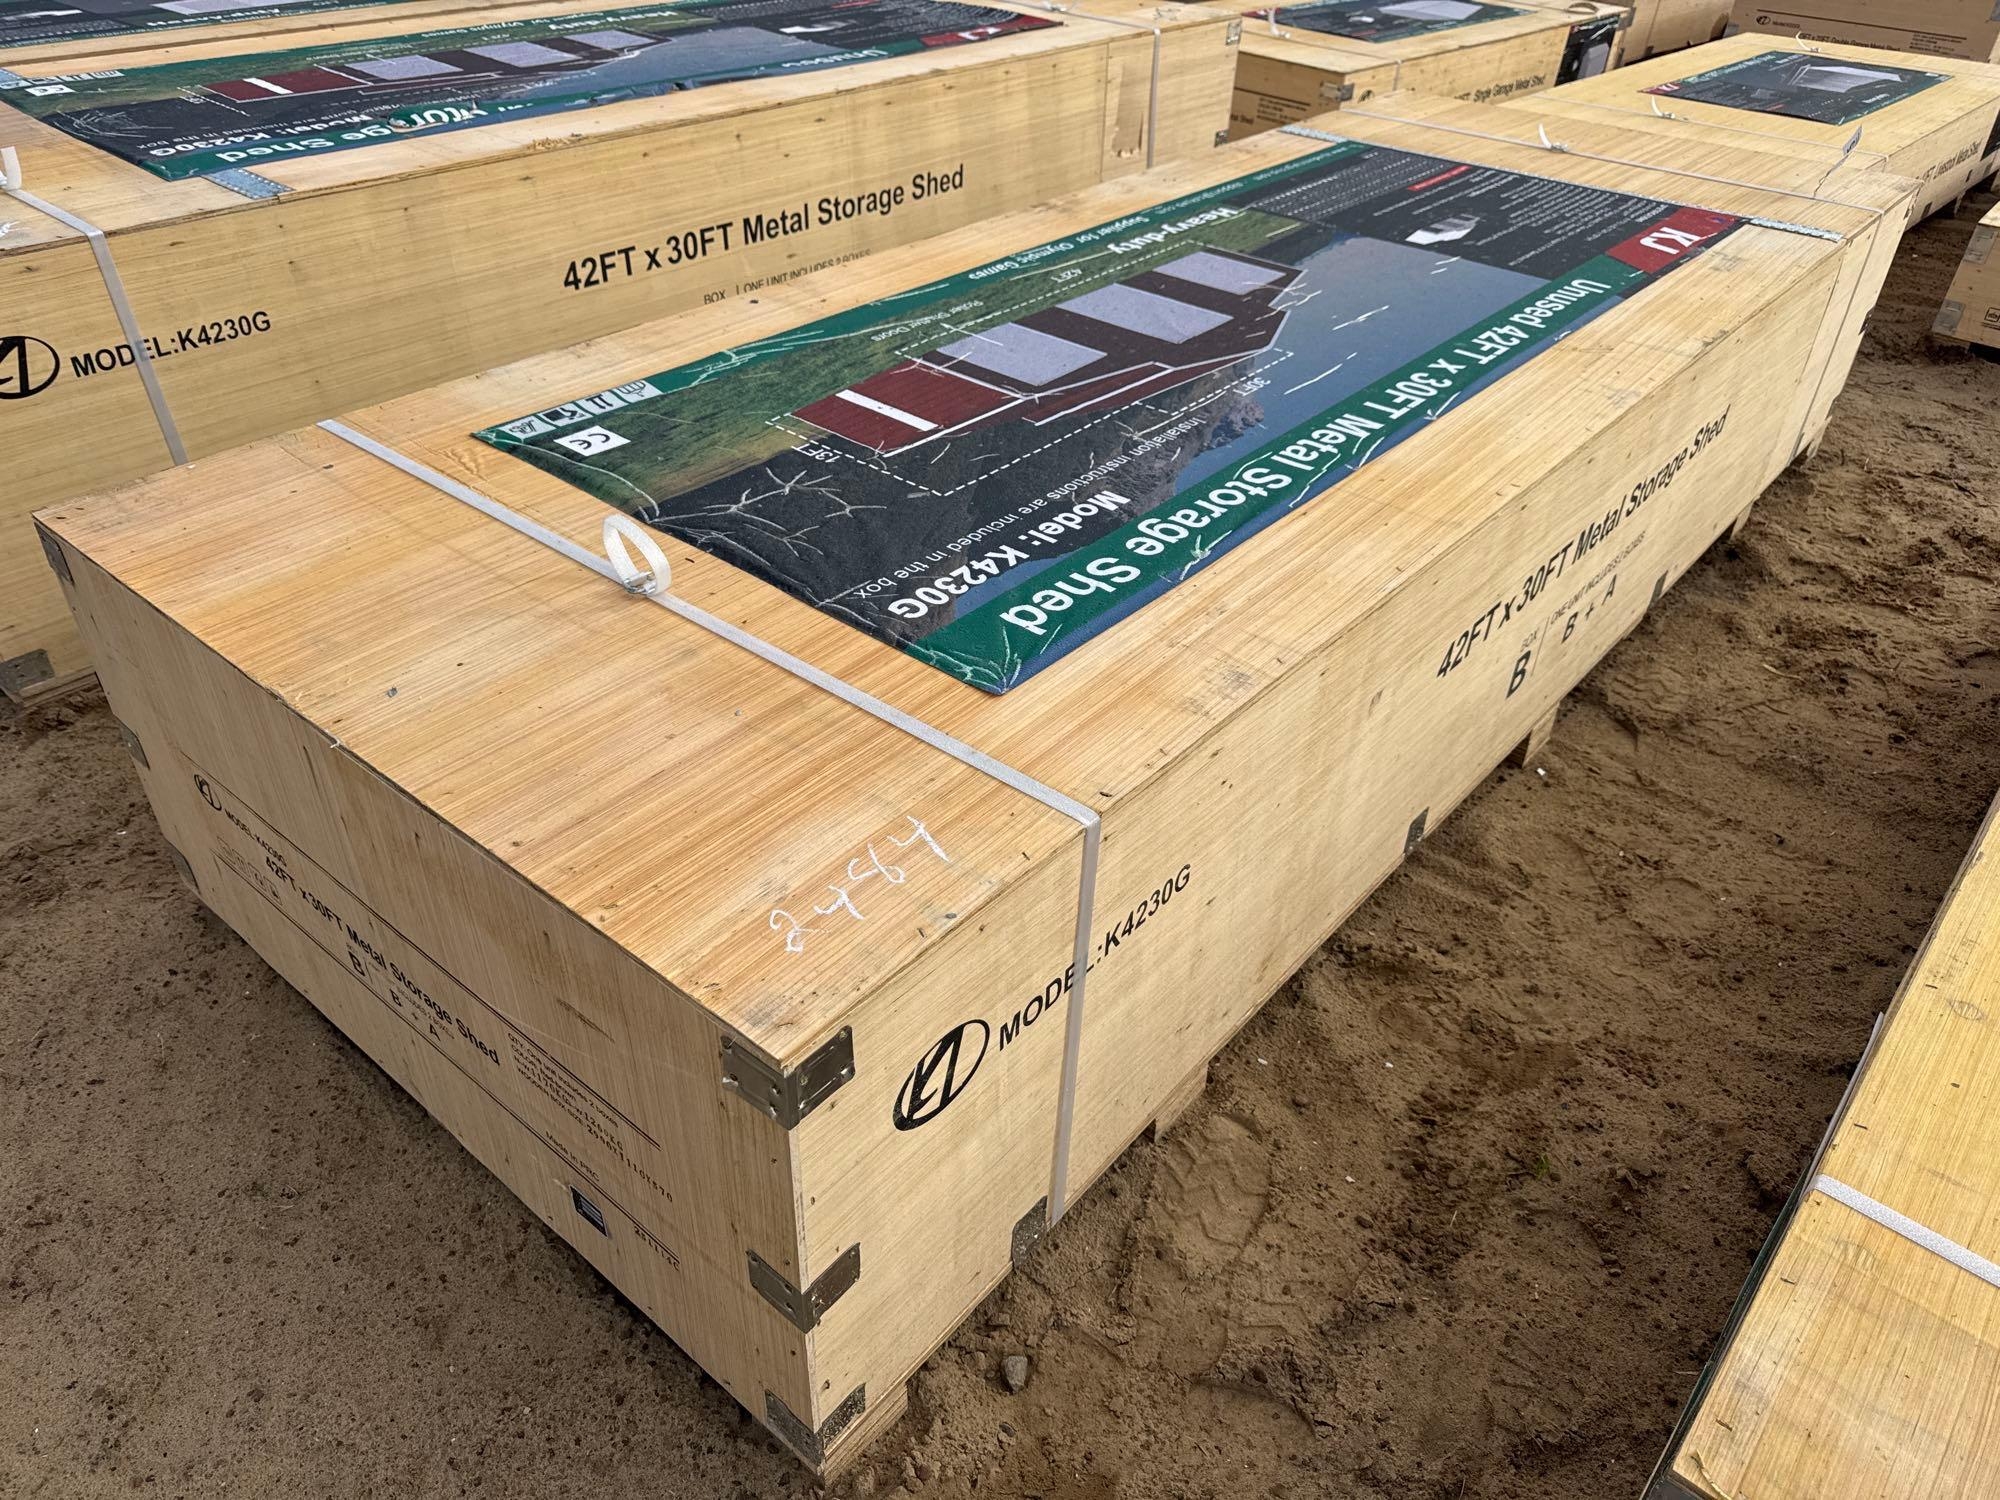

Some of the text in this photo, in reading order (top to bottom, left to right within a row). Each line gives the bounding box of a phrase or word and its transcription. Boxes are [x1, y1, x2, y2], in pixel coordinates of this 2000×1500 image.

[215, 137, 335, 163] Shed
[564, 164, 964, 291] 42FT x 30FT Metal Storage Shed
[1108, 207, 1237, 253] Heavy-duty
[1640, 227, 1702, 254] KJ
[704, 289, 726, 305] BOX
[1001, 279, 1610, 633] Unused 42FT x 30FT Metal Storage Shed
[853, 417, 1205, 598] Installation instructions are included in the box
[889, 490, 1129, 617] Model: K4230G
[1436, 404, 1731, 678] 42FT x 30FT Metal Storage Shed
[1561, 612, 1578, 644] B
[1602, 574, 1617, 606] A
[1505, 650, 1532, 700] B
[266, 856, 500, 1066] 42FT x 30FT Metal Storage Shed
[348, 951, 366, 976] B
[389, 988, 403, 1007] B
[429, 1023, 441, 1042] A
[545, 1131, 568, 1155] Made
